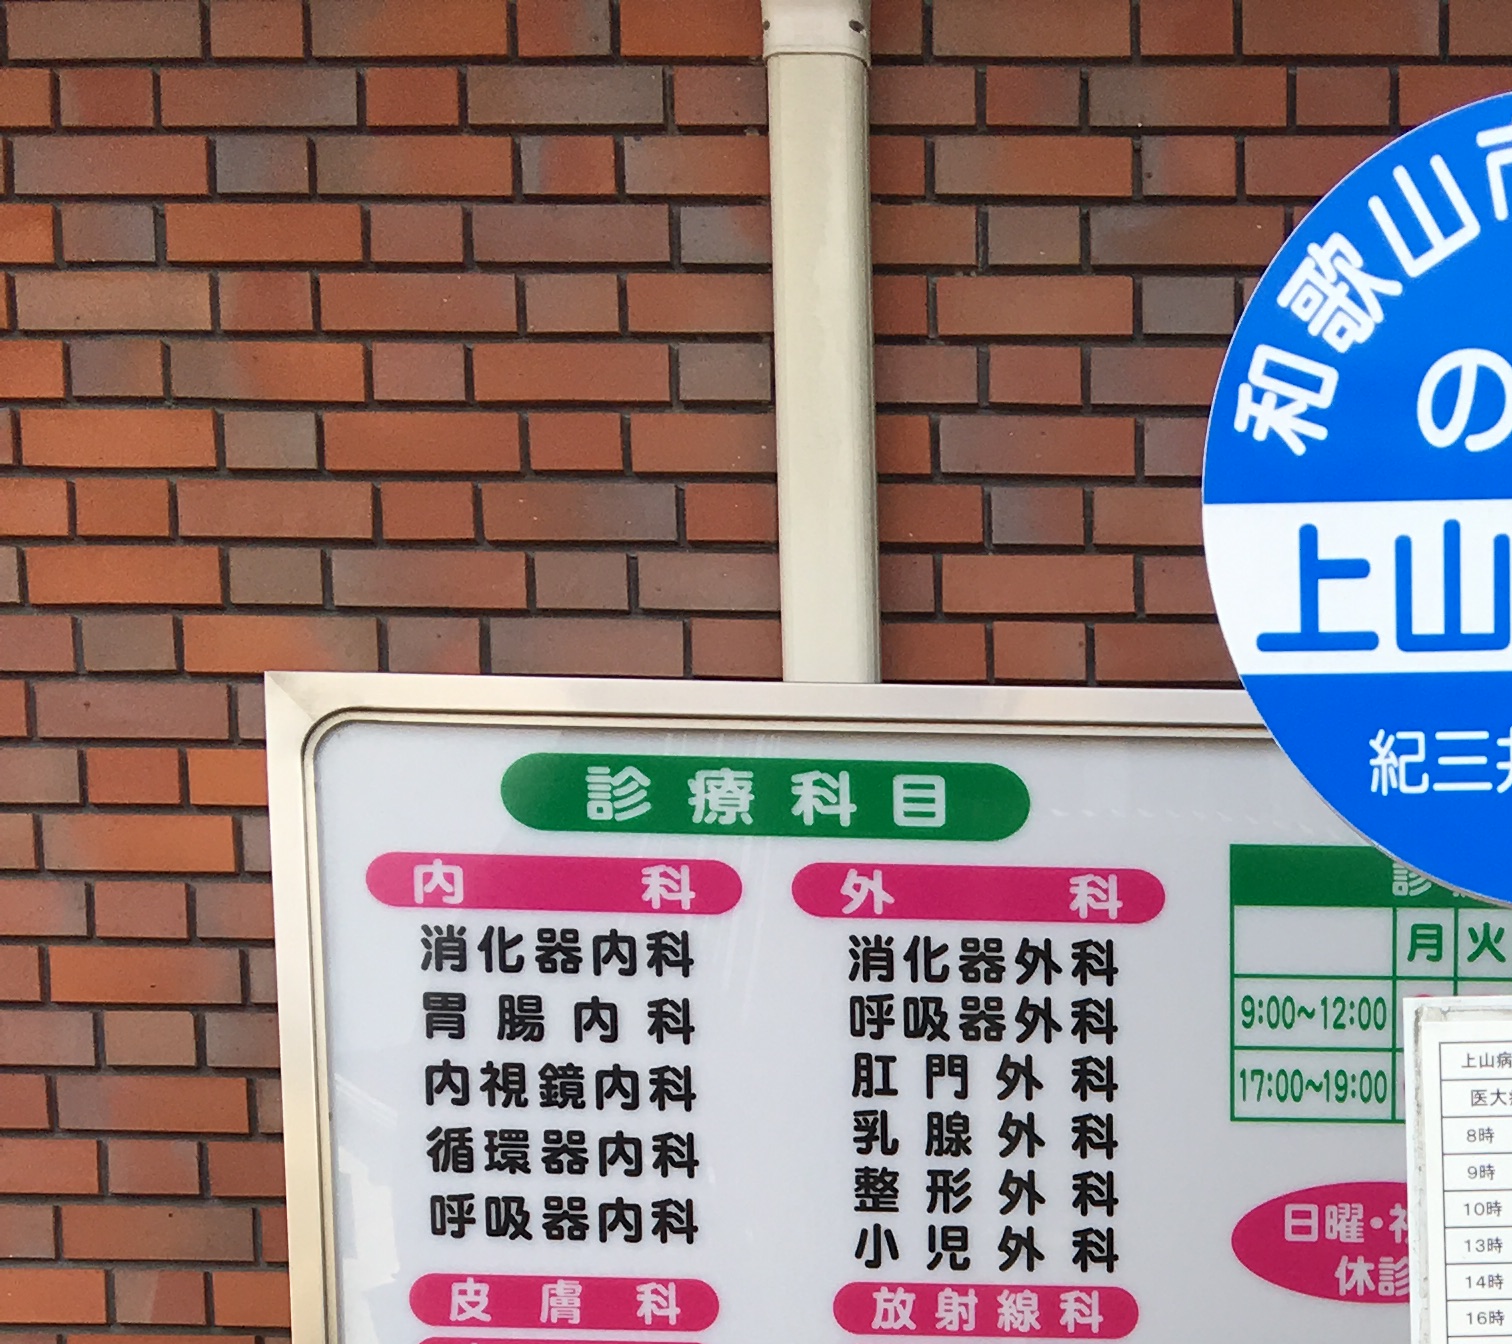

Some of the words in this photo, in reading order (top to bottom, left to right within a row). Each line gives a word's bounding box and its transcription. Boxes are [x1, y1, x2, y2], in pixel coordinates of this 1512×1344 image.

[585, 766, 946, 828] 診療科目
[412, 859, 696, 910] 内科
[840, 870, 1122, 919] 外科
[421, 924, 694, 978] 消化器内科
[849, 934, 1119, 986] 消化器外科
[1407, 923, 1443, 962] 月
[1467, 921, 1506, 963] 火
[423, 991, 695, 1045] 胃腸内科
[850, 993, 1119, 1044] 呼吸器外科
[425, 1058, 697, 1112] 内視鏡内科
[852, 1052, 1119, 1102] 肛門外科
[426, 1126, 699, 1178] 循環器内科
[853, 1109, 1119, 1160] 乳腺外科
[1466, 1126, 1495, 1145] 8時
[854, 1166, 1119, 1217] 整形外科
[1467, 1163, 1496, 1181] 9時
[430, 1193, 698, 1244] 呼吸器内科
[1463, 1200, 1502, 1217] 10時
[854, 1223, 1119, 1273] 小児外科
[1464, 1237, 1503, 1254] 13時
[449, 1277, 681, 1326] 皮膚科
[1465, 1273, 1504, 1290] 14時
[872, 1287, 1104, 1333] 放射線科
[1466, 1309, 1505, 1327] 16時
